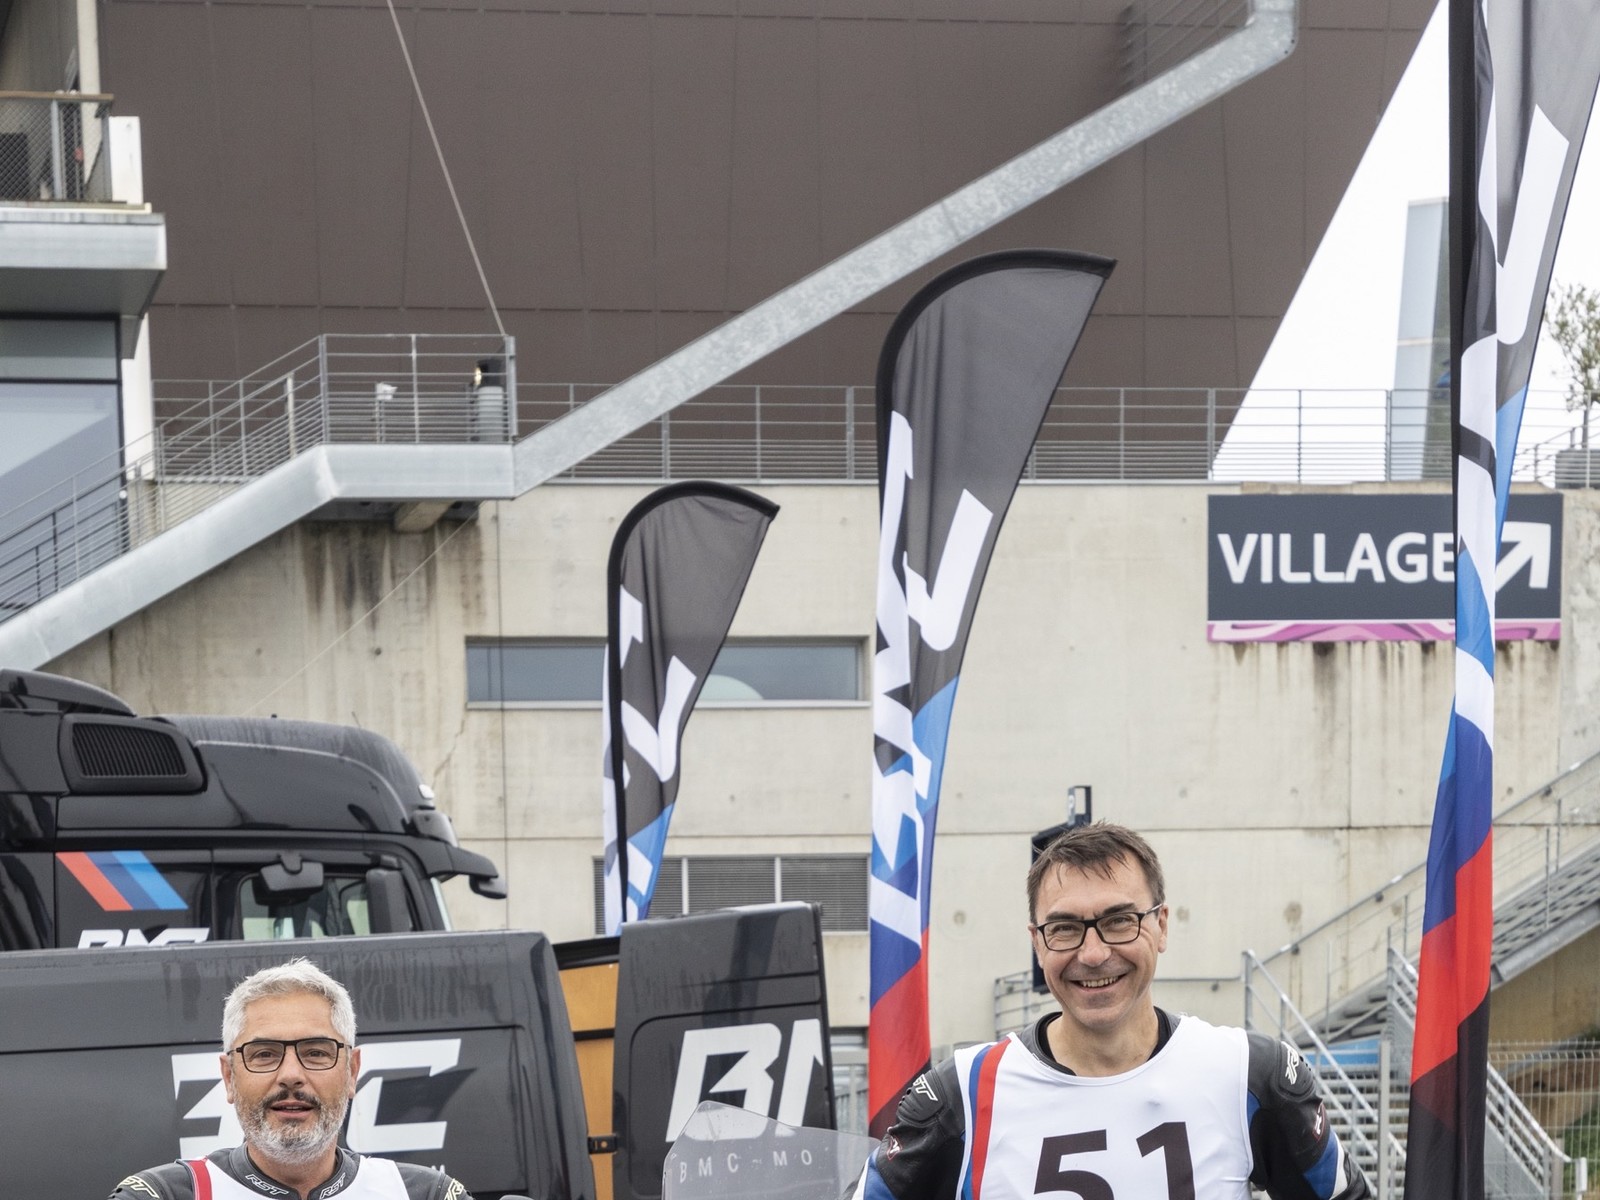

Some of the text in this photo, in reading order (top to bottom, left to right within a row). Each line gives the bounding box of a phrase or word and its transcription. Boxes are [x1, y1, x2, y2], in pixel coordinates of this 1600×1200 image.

[1217, 532, 1455, 583] VILLAGE
[245, 1173, 289, 1196] RST
[319, 1172, 346, 1200] RST
